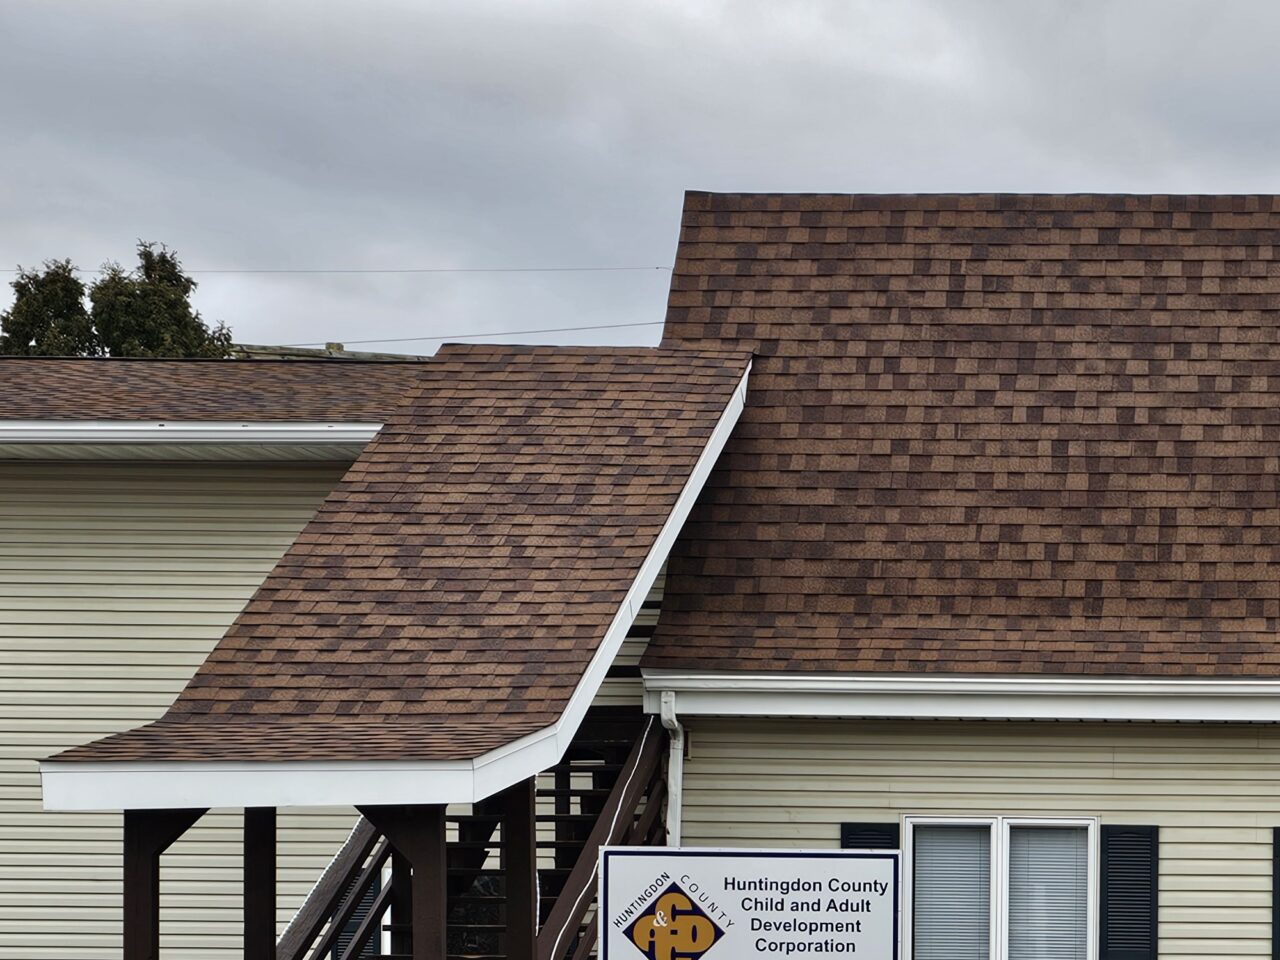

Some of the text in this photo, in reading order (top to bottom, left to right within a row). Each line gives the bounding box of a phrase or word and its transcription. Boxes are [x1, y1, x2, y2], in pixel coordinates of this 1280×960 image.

[724, 876, 889, 896] Huntingdon County
[612, 871, 671, 929] HUNTINGDON
[680, 874, 735, 929] COUNTY
[741, 897, 871, 913] Child and Adult
[750, 917, 862, 935] Development
[755, 937, 856, 955] Corporation
